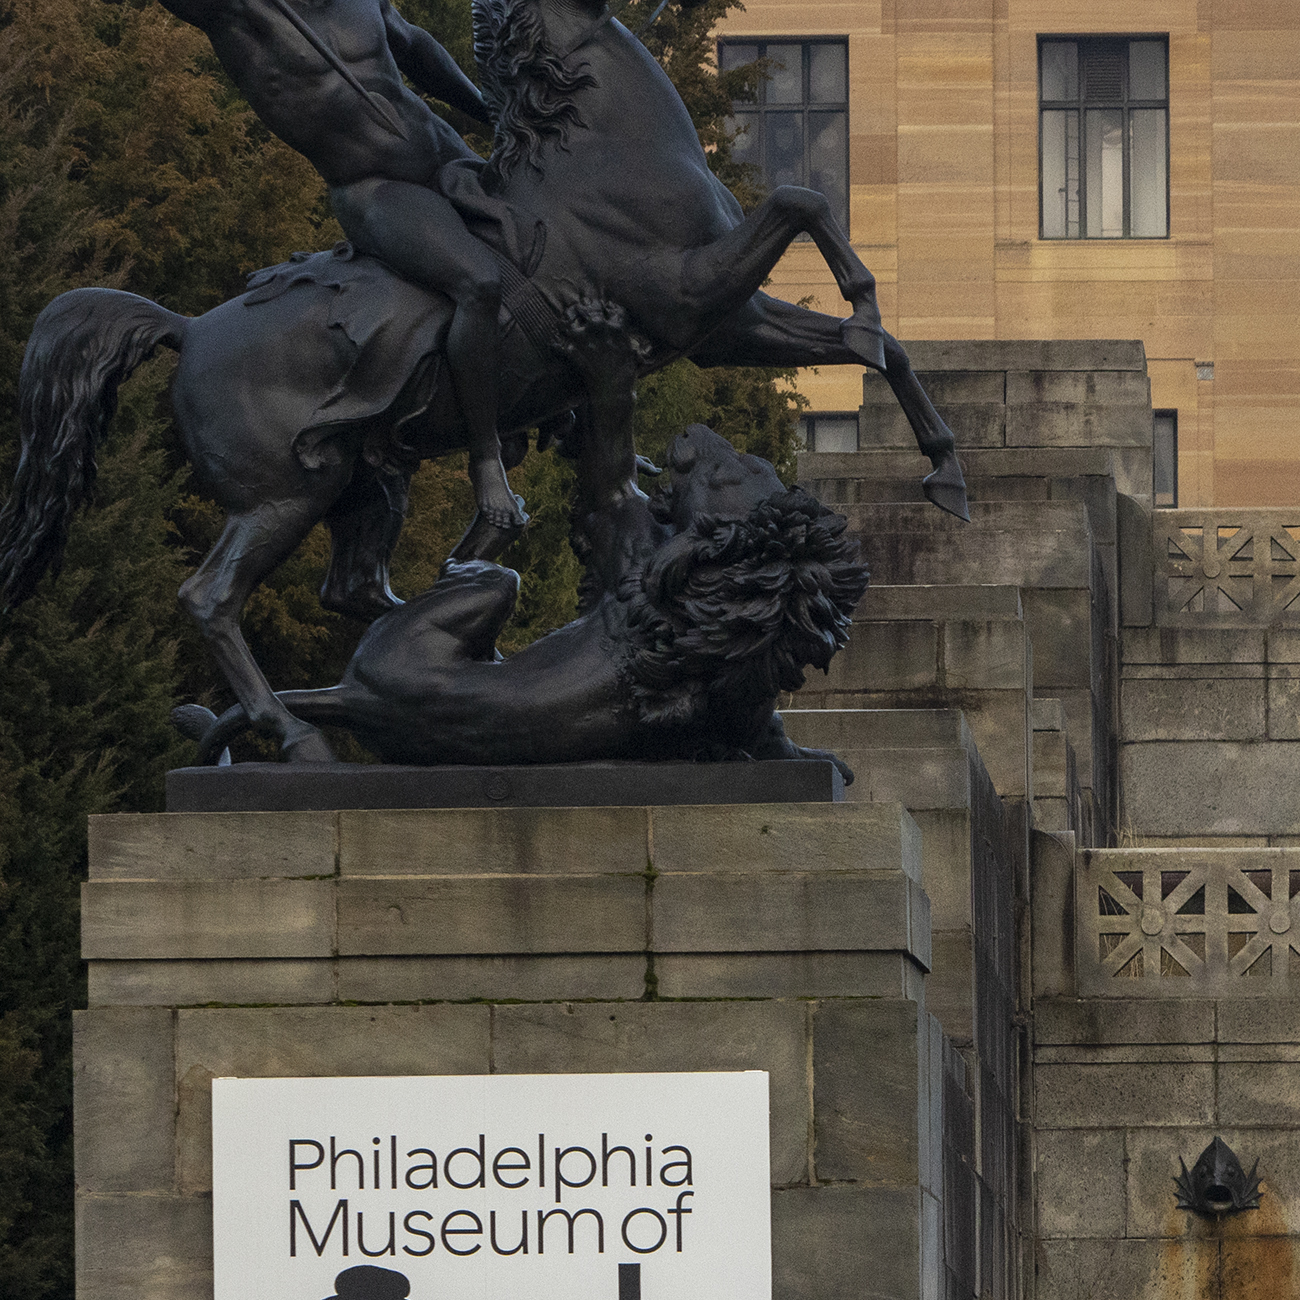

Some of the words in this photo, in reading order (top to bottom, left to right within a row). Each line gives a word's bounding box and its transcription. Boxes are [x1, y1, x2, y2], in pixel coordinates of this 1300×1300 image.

[289, 1133, 694, 1203] Philadelphia
[290, 1199, 604, 1257] Museum
[621, 1190, 694, 1254] of
